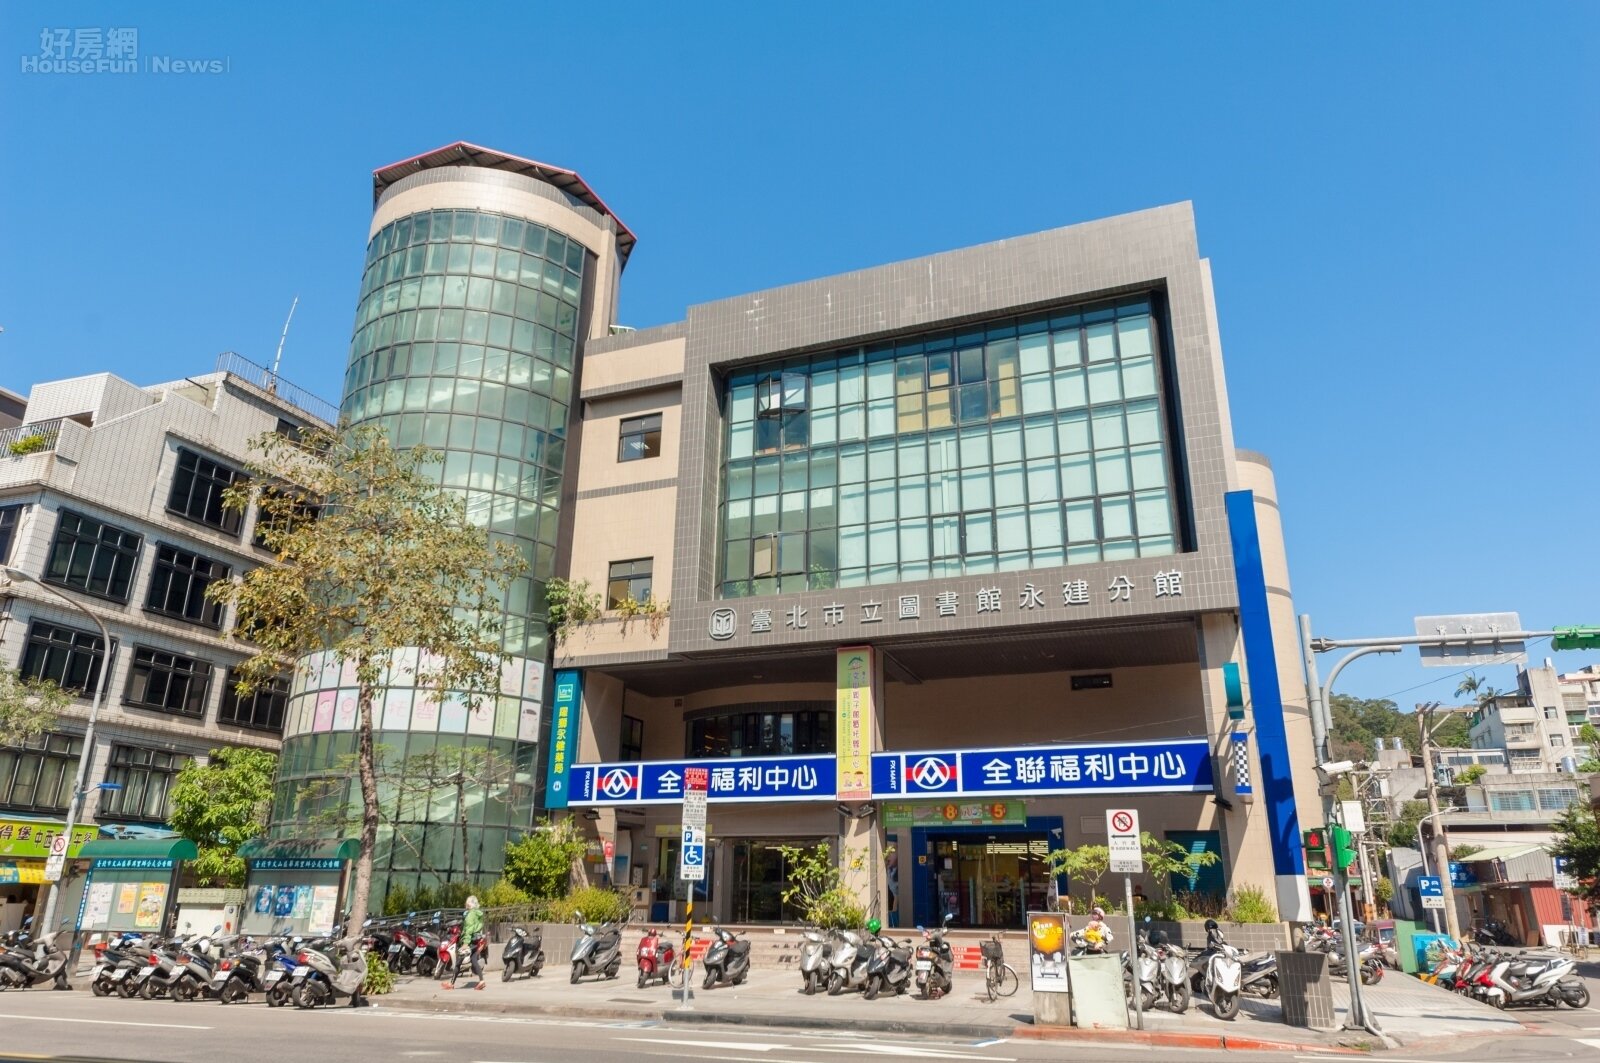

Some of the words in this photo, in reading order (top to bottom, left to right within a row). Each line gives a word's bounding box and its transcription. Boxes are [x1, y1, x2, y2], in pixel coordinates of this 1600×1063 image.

[751, 569, 1182, 633] 臺北市立圖書館永建分館
[890, 760, 896, 768] PX
[981, 750, 1187, 785] 全聯福利中心
[585, 771, 590, 779] PX
[658, 764, 818, 794] 全福利中心
[1420, 879, 1430, 890] P
